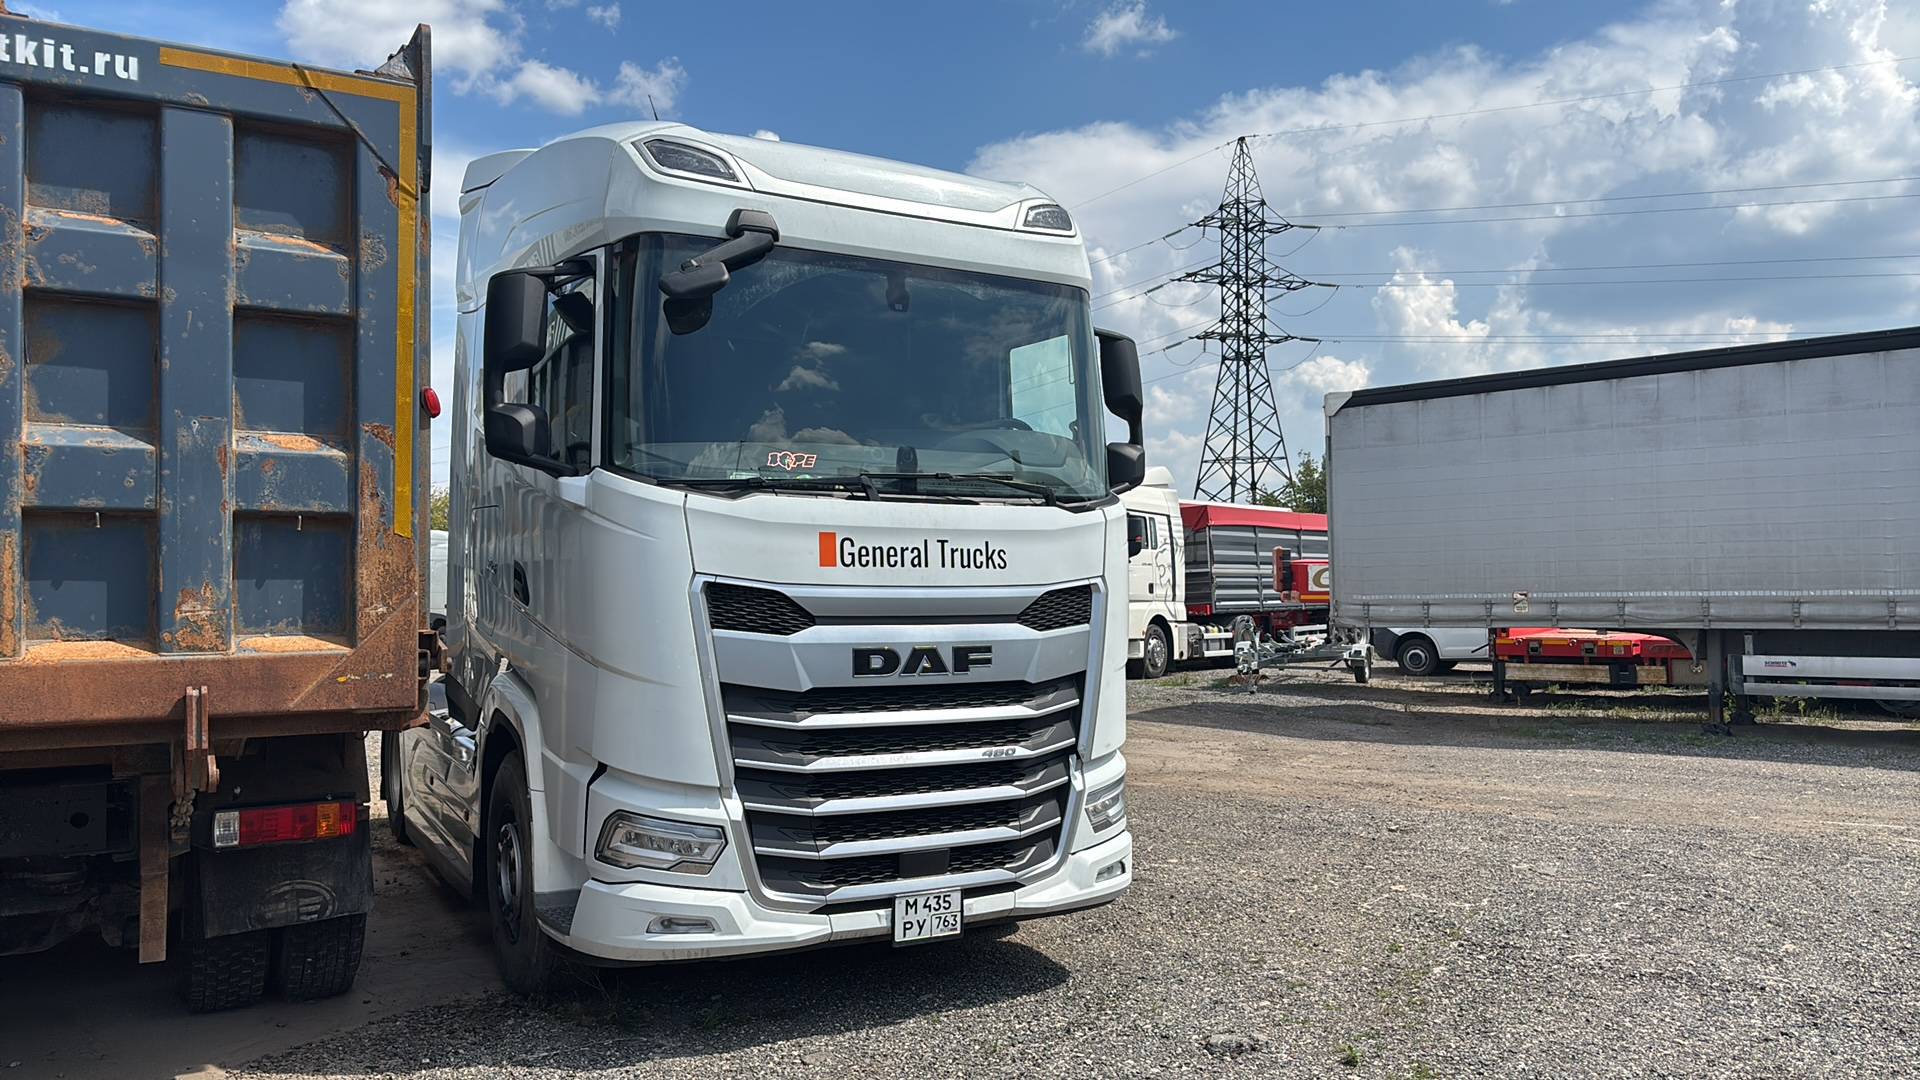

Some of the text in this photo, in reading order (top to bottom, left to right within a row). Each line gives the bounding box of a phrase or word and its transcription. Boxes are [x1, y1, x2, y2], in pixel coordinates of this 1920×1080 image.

[839, 537, 1007, 569] General Trucks
[852, 645, 992, 678] DAF
[905, 894, 951, 916] М 435
[903, 914, 958, 939] РУ 763
